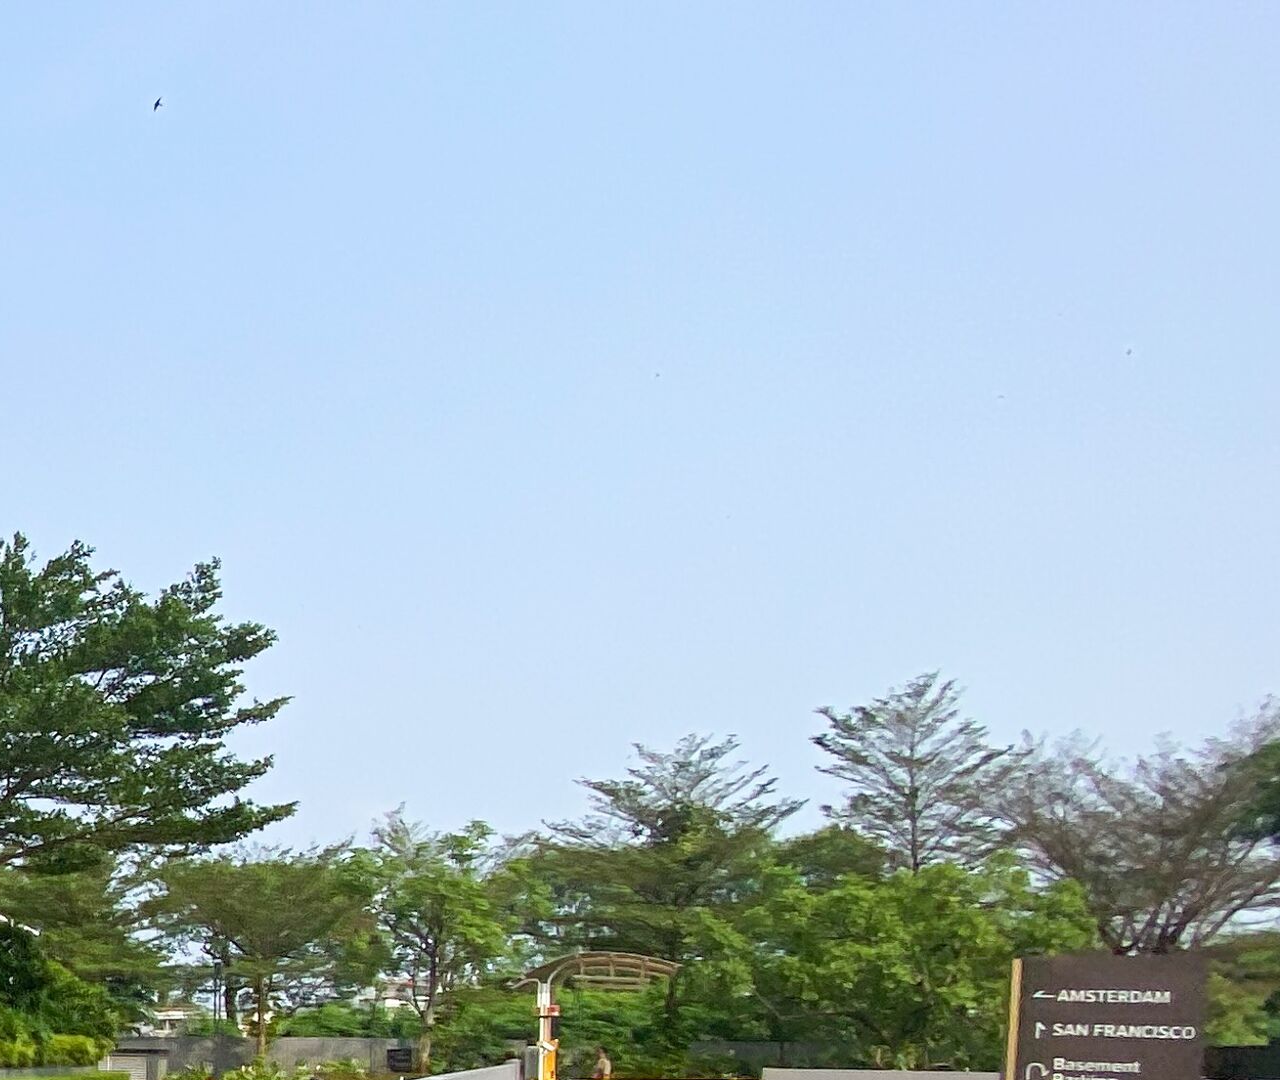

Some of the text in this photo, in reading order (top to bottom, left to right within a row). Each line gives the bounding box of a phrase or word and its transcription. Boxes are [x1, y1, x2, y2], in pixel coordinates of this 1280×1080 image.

[1057, 990, 1171, 1004] AMSTERDAM
[1051, 1022, 1197, 1040] SAN FRANCISCO
[1053, 1057, 1141, 1073] Basement
